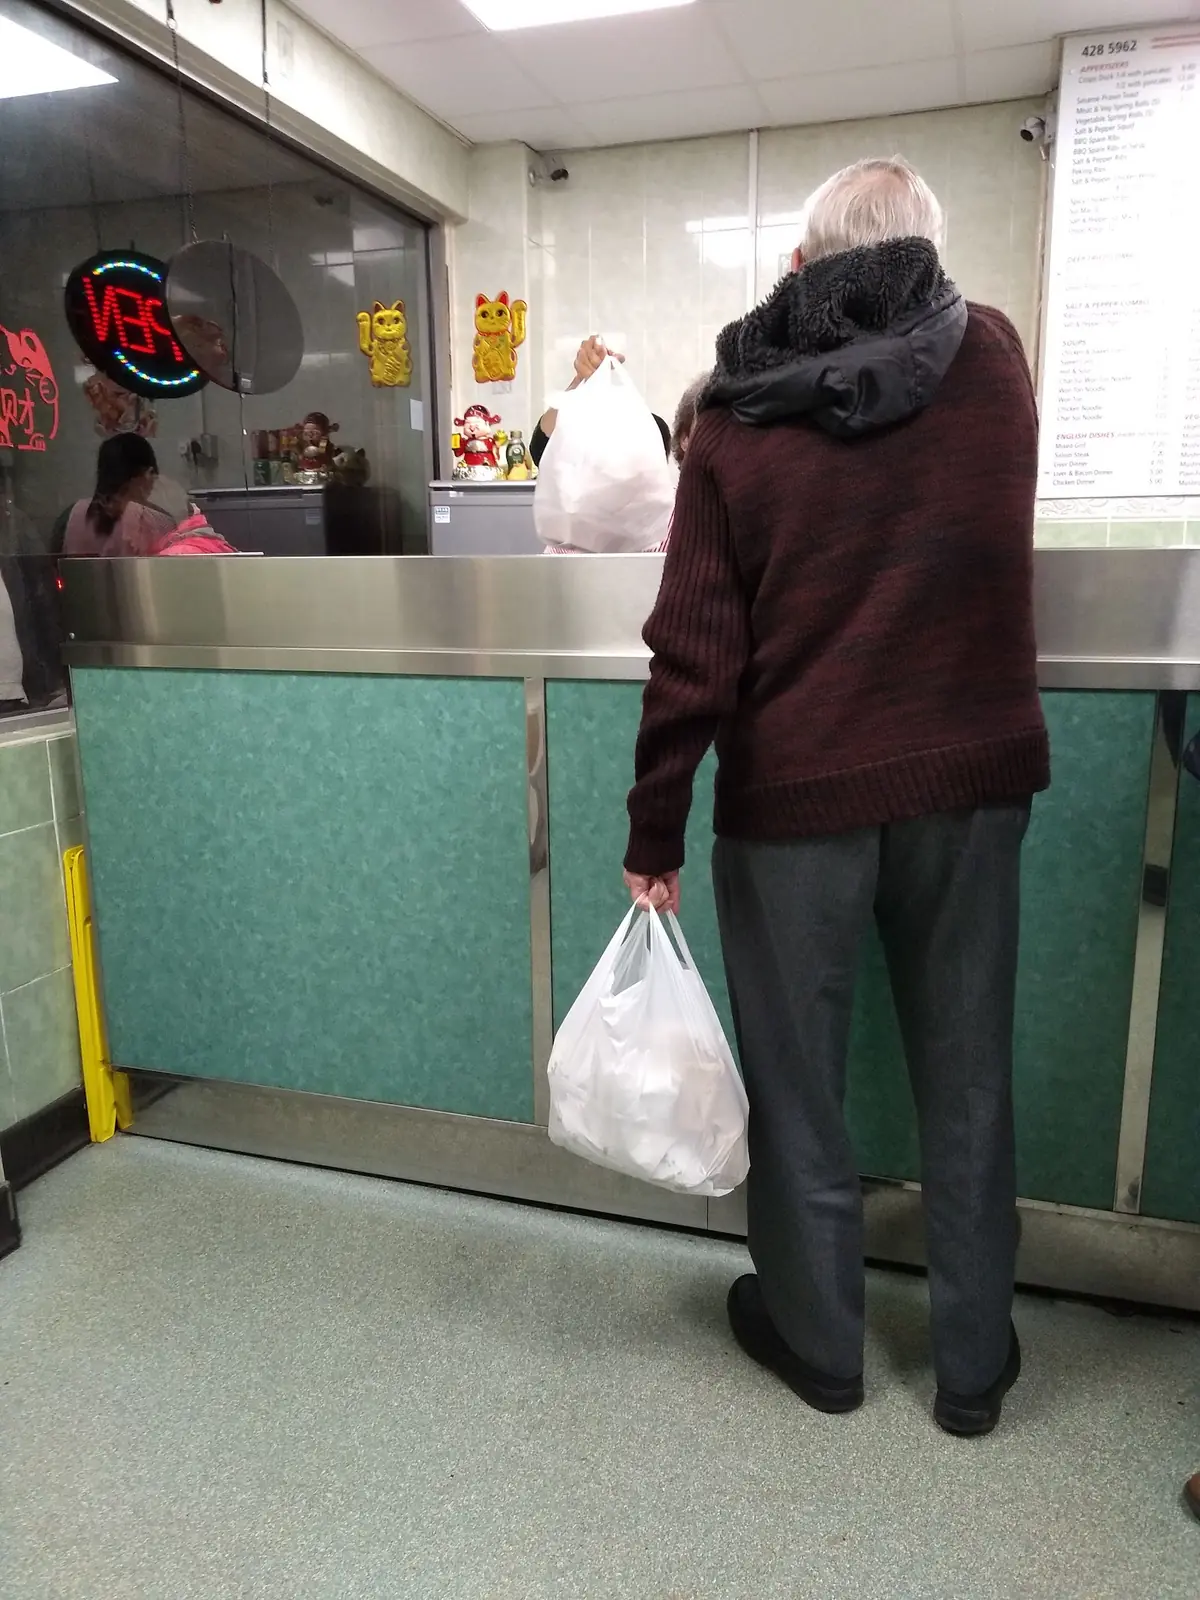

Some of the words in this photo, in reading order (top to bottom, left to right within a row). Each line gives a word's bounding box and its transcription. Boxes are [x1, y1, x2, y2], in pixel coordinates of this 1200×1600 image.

[1081, 43, 1104, 57] 428
[1107, 40, 1138, 55] 5962
[1127, 80, 1141, 88] with
[1094, 126, 1115, 134] Pepper
[1073, 147, 1087, 155] BBQ
[1072, 158, 1084, 166] Salt
[1062, 339, 1087, 347] SOUPS
[1056, 433, 1087, 441] ENGLISH
[1089, 431, 1115, 440] DISHES
[1052, 479, 1075, 487] Chicken
